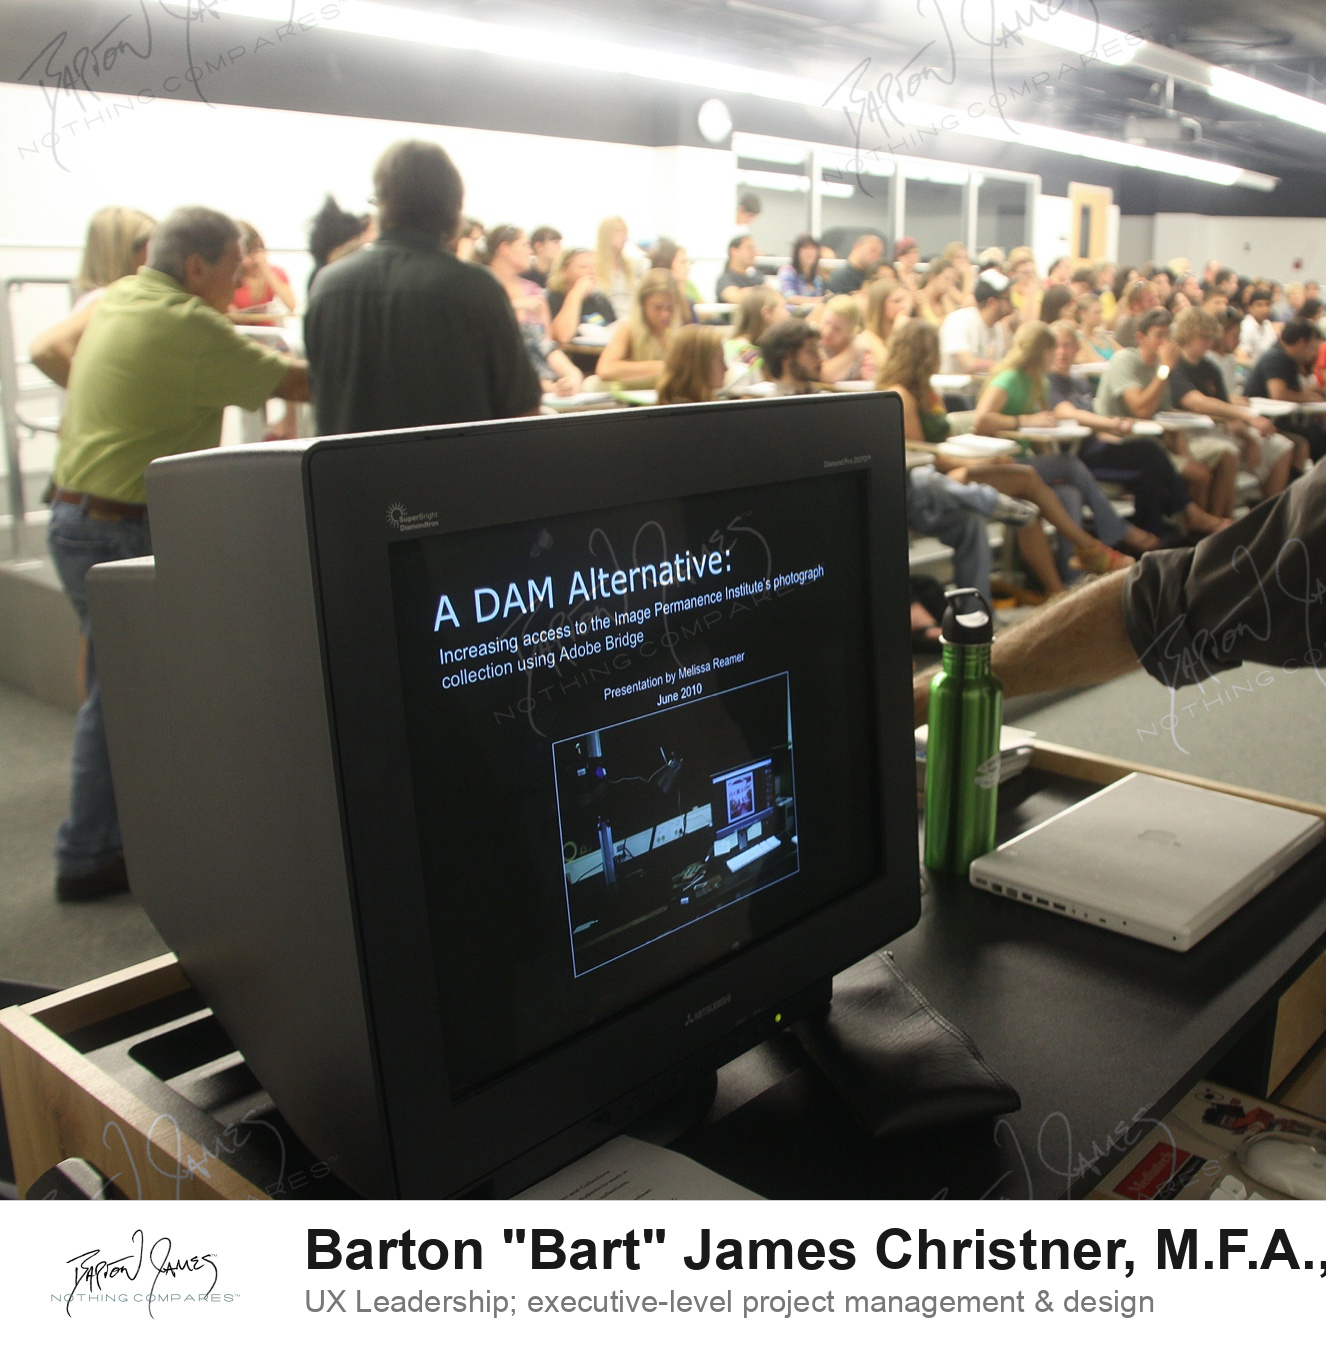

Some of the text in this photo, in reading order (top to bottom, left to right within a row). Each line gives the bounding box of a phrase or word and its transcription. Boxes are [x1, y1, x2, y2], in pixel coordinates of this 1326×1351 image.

[399, 511, 438, 523] SuperBright
[400, 520, 439, 531] Diamondtron
[433, 549, 731, 632] A DAM Alternative:
[439, 564, 825, 665] Increasing access to the Image Permanence Institute's photograph
[442, 629, 644, 690] collection using Adobe Bridge
[604, 651, 745, 700] Presentation by Melissa Reamer
[657, 683, 703, 707] June 2010
